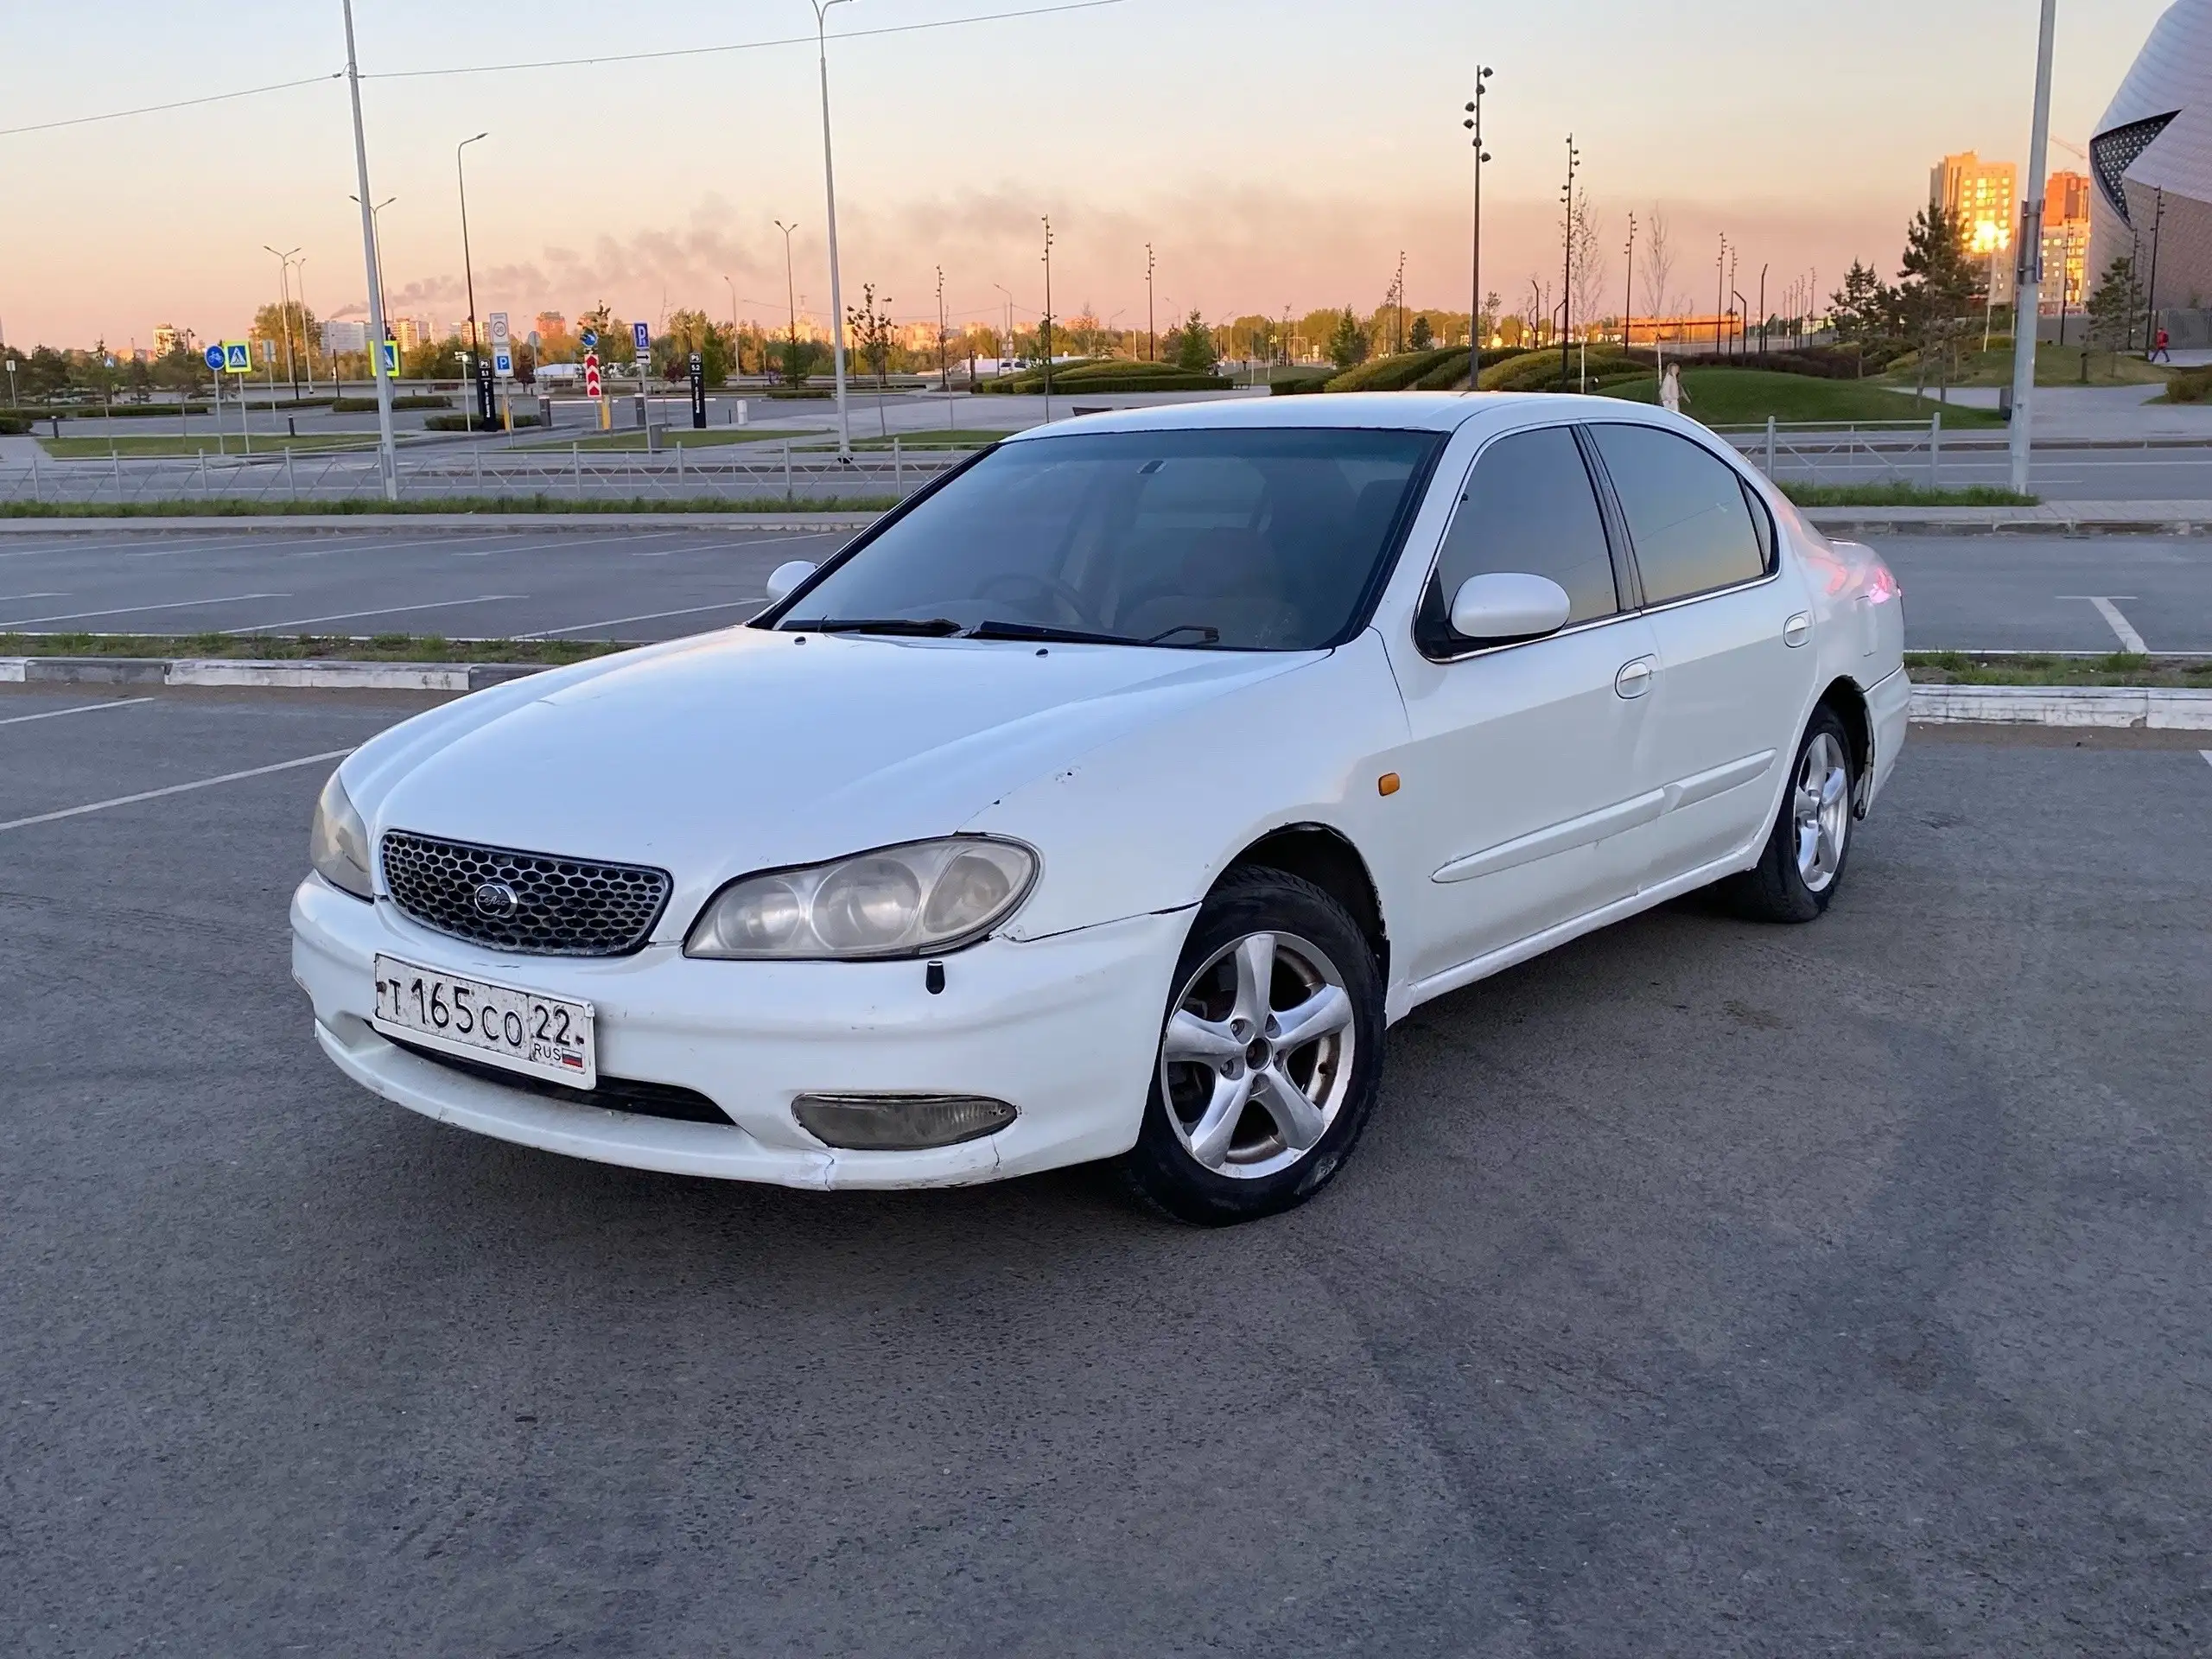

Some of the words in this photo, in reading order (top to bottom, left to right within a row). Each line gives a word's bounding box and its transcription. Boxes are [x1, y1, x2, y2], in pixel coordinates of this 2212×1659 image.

[499, 357, 508, 369] P
[534, 1004, 571, 1046] 22
[534, 1042, 562, 1061] RUS
